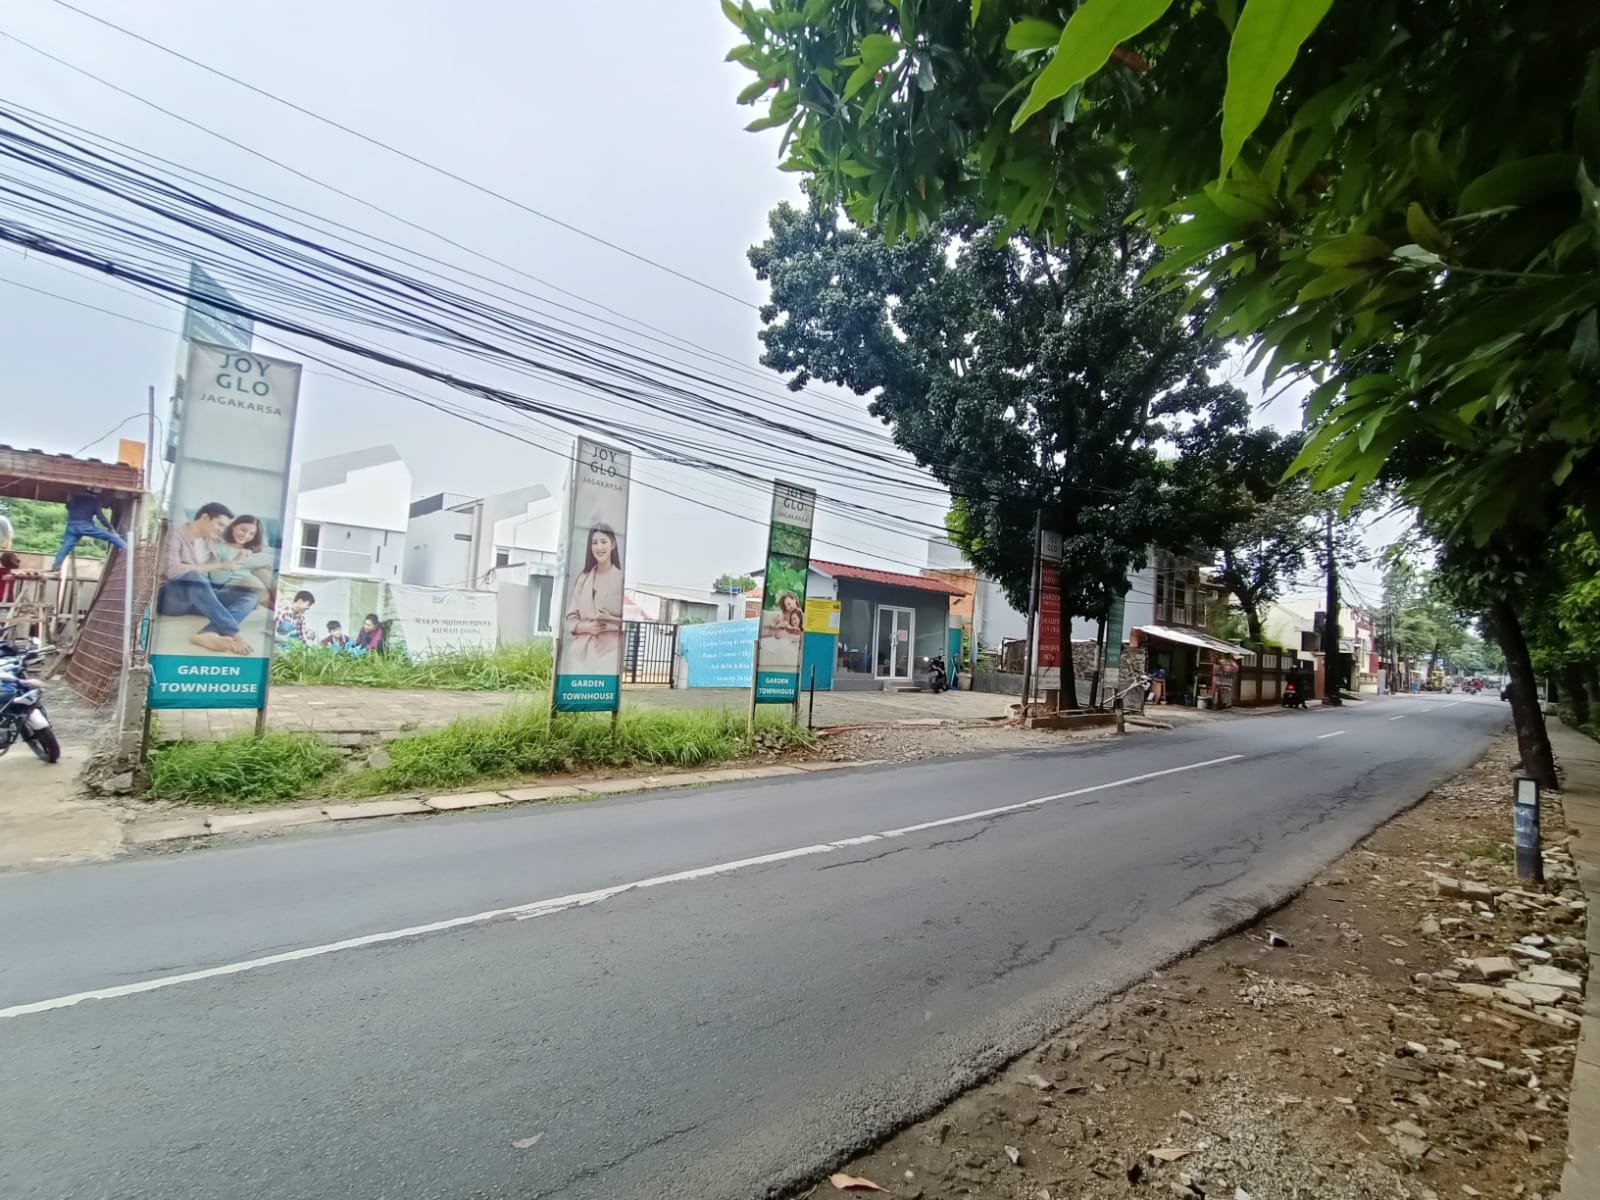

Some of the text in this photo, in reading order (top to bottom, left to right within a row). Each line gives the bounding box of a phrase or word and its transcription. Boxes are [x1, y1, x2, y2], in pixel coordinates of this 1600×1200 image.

[220, 355, 271, 377] JOY
[216, 373, 270, 397] GLO
[200, 393, 282, 416] JAGAKARSA
[592, 447, 617, 463] JOY
[591, 461, 616, 478] GLO
[783, 498, 804, 512] GLO
[177, 665, 241, 676] GARDEN
[571, 679, 605, 688] GARDEN
[765, 677, 789, 685] GARDEN
[159, 682, 258, 693] TOWNHOUSE
[759, 687, 795, 695] TOWNHOUSE
[562, 692, 615, 700] TOWNHOUSE
